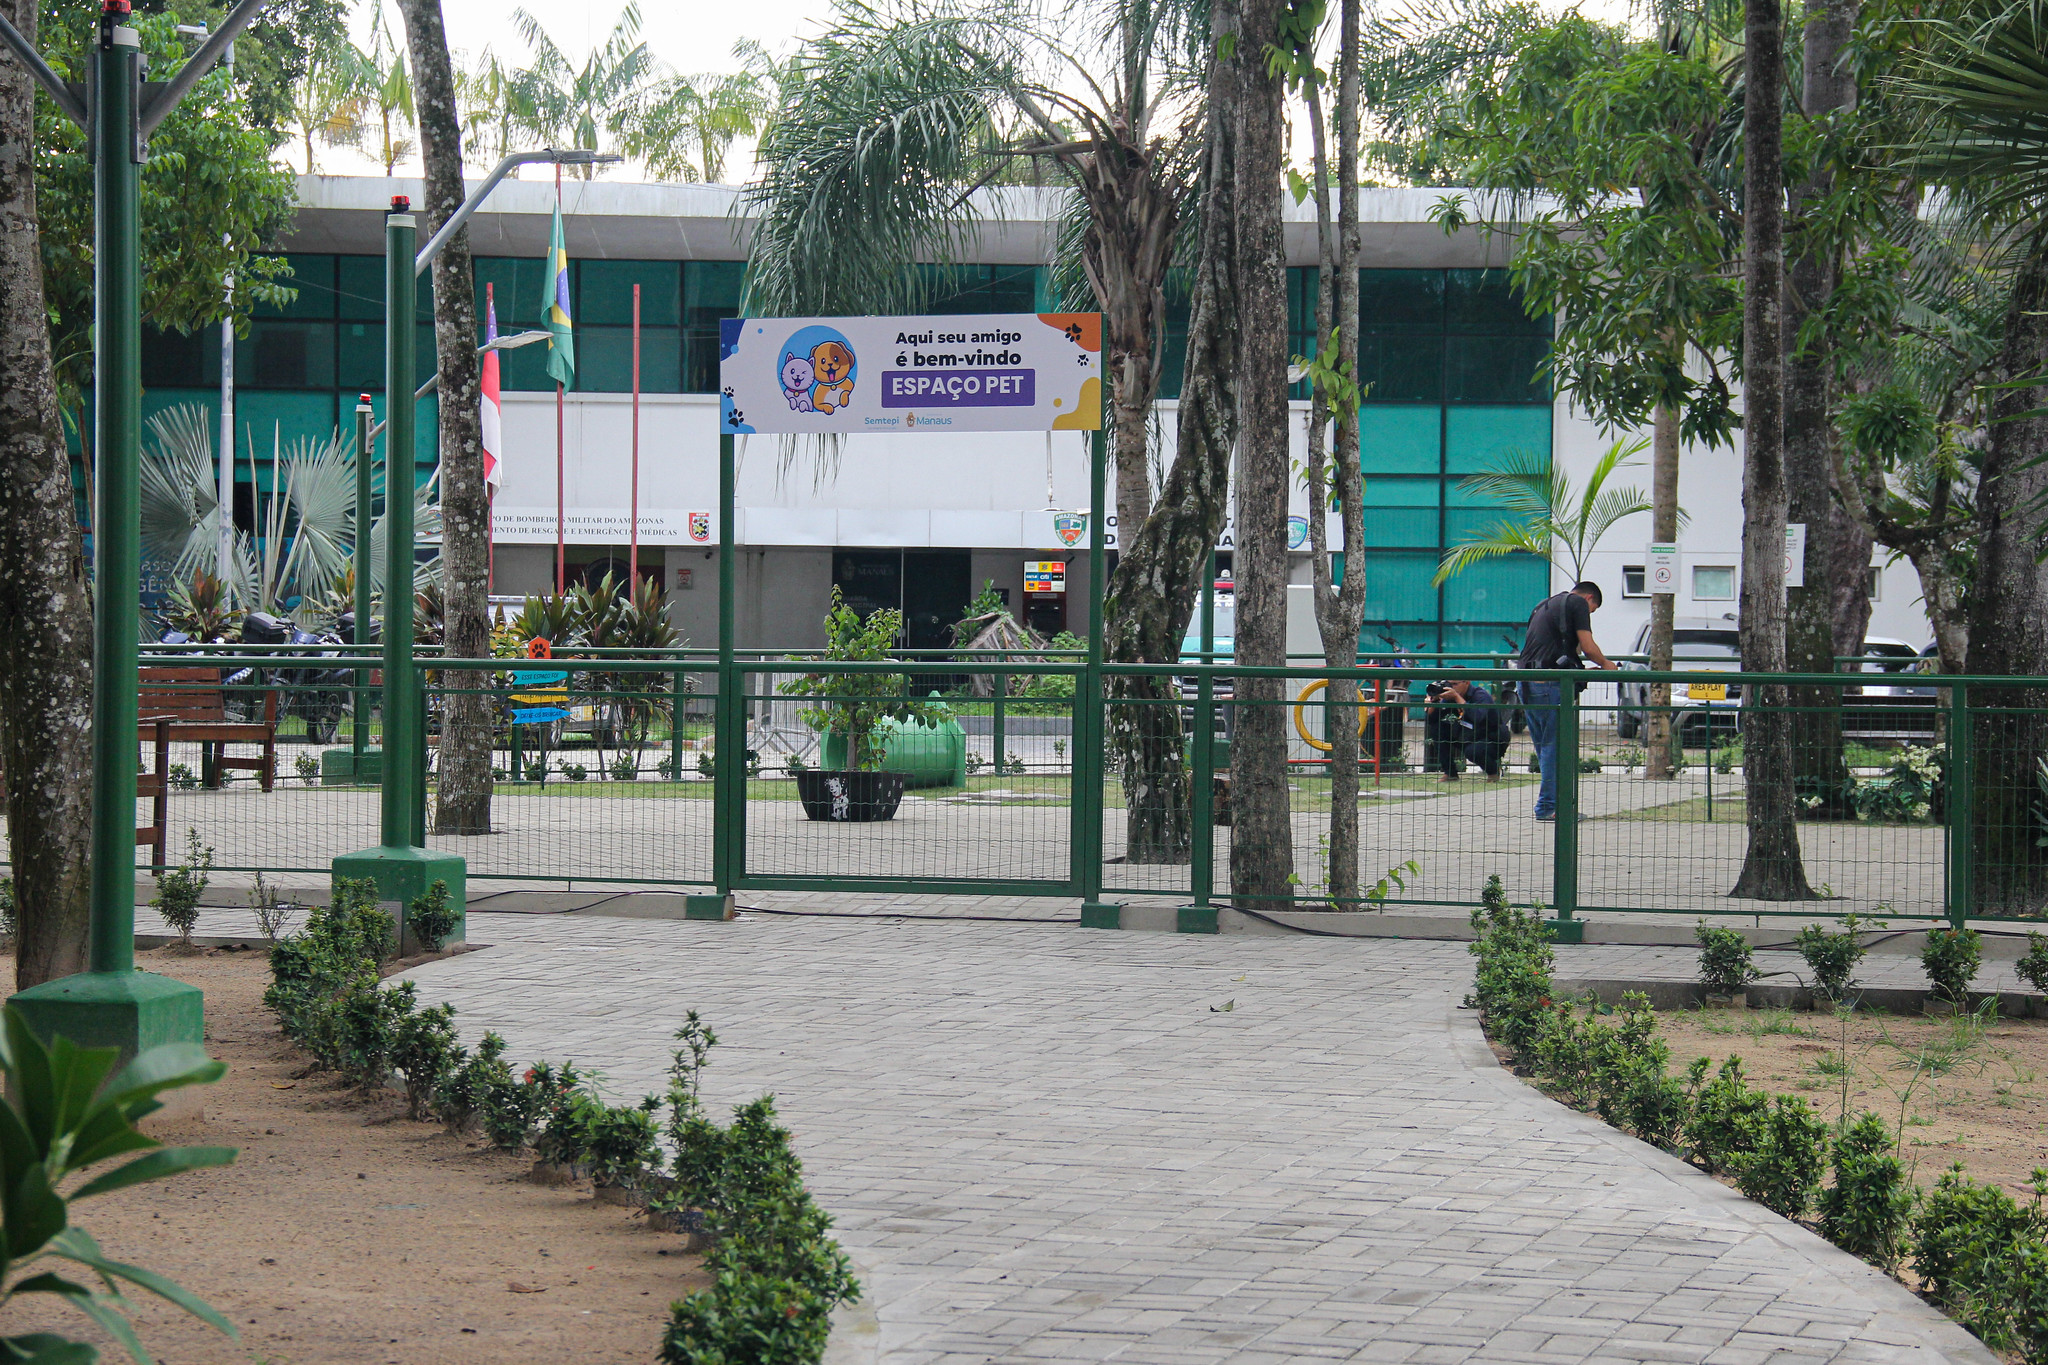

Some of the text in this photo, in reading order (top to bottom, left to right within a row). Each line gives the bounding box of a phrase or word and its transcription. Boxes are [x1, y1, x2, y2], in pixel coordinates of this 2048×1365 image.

[895, 329, 1022, 346] Aqui seu amigo
[895, 348, 1022, 367] é bem-vindo
[892, 376, 1024, 400] ESPAÇO PET
[864, 416, 953, 426] Semtepi Manaus
[567, 516, 603, 524] MILITAR
[604, 516, 616, 524] DO
[618, 516, 664, 525] AMZONAS
[531, 527, 571, 535] RESGAE
[578, 526, 638, 535] EMERGÊNCIA
[640, 527, 678, 536] MÉDICAS
